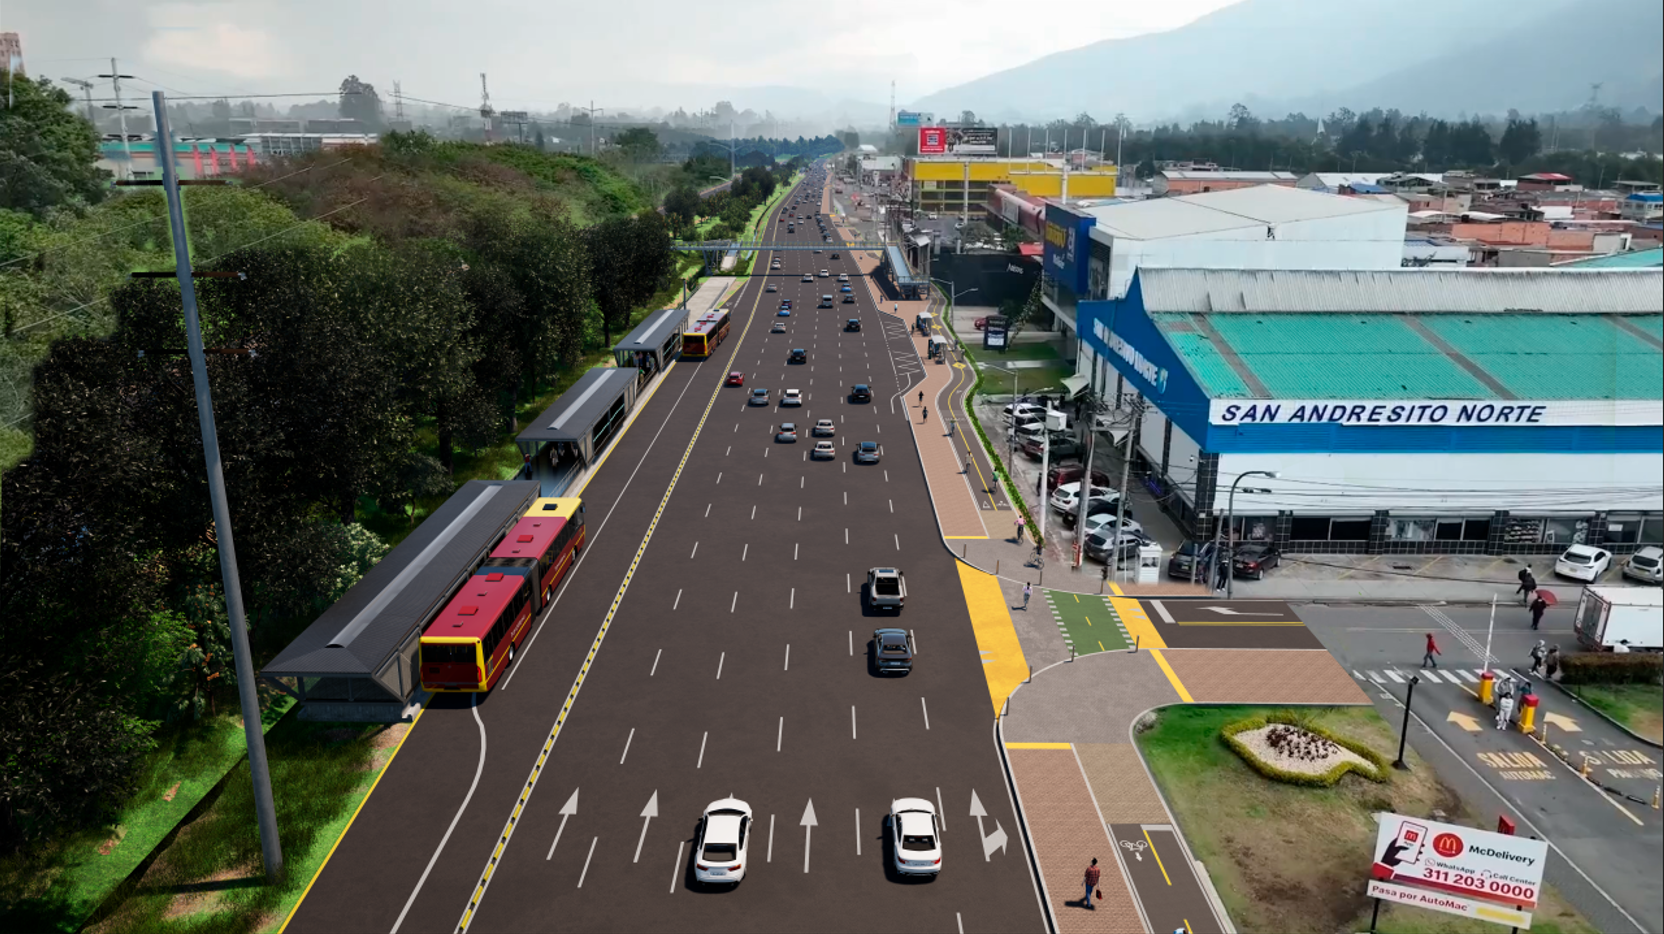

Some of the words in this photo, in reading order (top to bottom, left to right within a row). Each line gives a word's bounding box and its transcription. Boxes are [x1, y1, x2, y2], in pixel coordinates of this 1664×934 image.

[1221, 404, 1281, 422] SAN
[1288, 404, 1448, 423] ANDRESITO
[1456, 404, 1547, 423] NORTE
[1476, 751, 1548, 768] SALIDA
[1468, 844, 1535, 866] McDelivery
[1436, 861, 1476, 875] WhatsApp
[1423, 867, 1449, 881] 311
[1453, 873, 1485, 890] 203
[1489, 881, 1534, 900] 0000
[1493, 872, 1508, 880] Call
[1509, 875, 1537, 887] Center
[1372, 885, 1398, 897] Pasa
[1399, 889, 1418, 901] por
[1419, 894, 1469, 912] AutoMac
